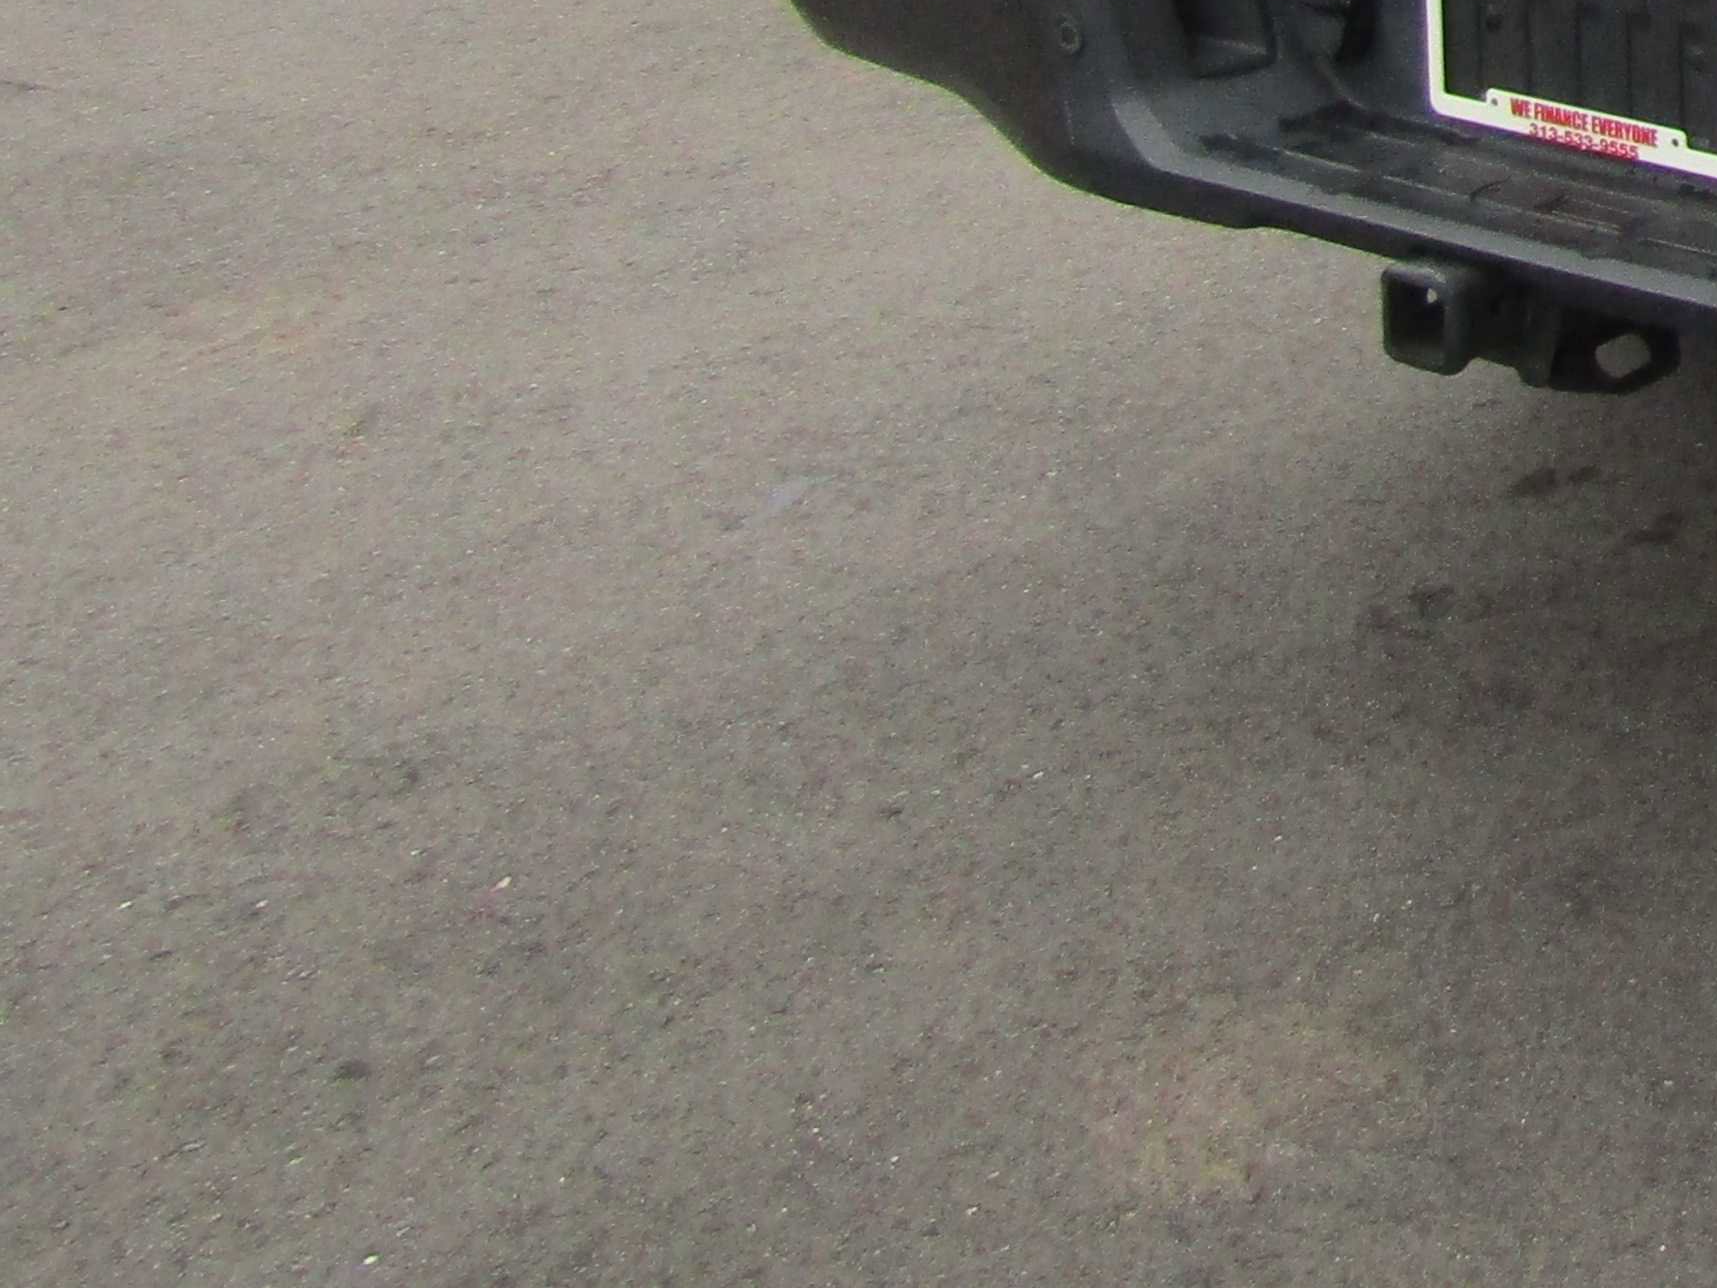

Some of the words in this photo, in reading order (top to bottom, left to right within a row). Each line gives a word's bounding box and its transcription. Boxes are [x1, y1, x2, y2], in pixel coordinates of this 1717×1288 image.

[1510, 97, 1531, 118] WE
[1534, 102, 1588, 131] FINANCE
[1591, 114, 1658, 147] EVERYONE
